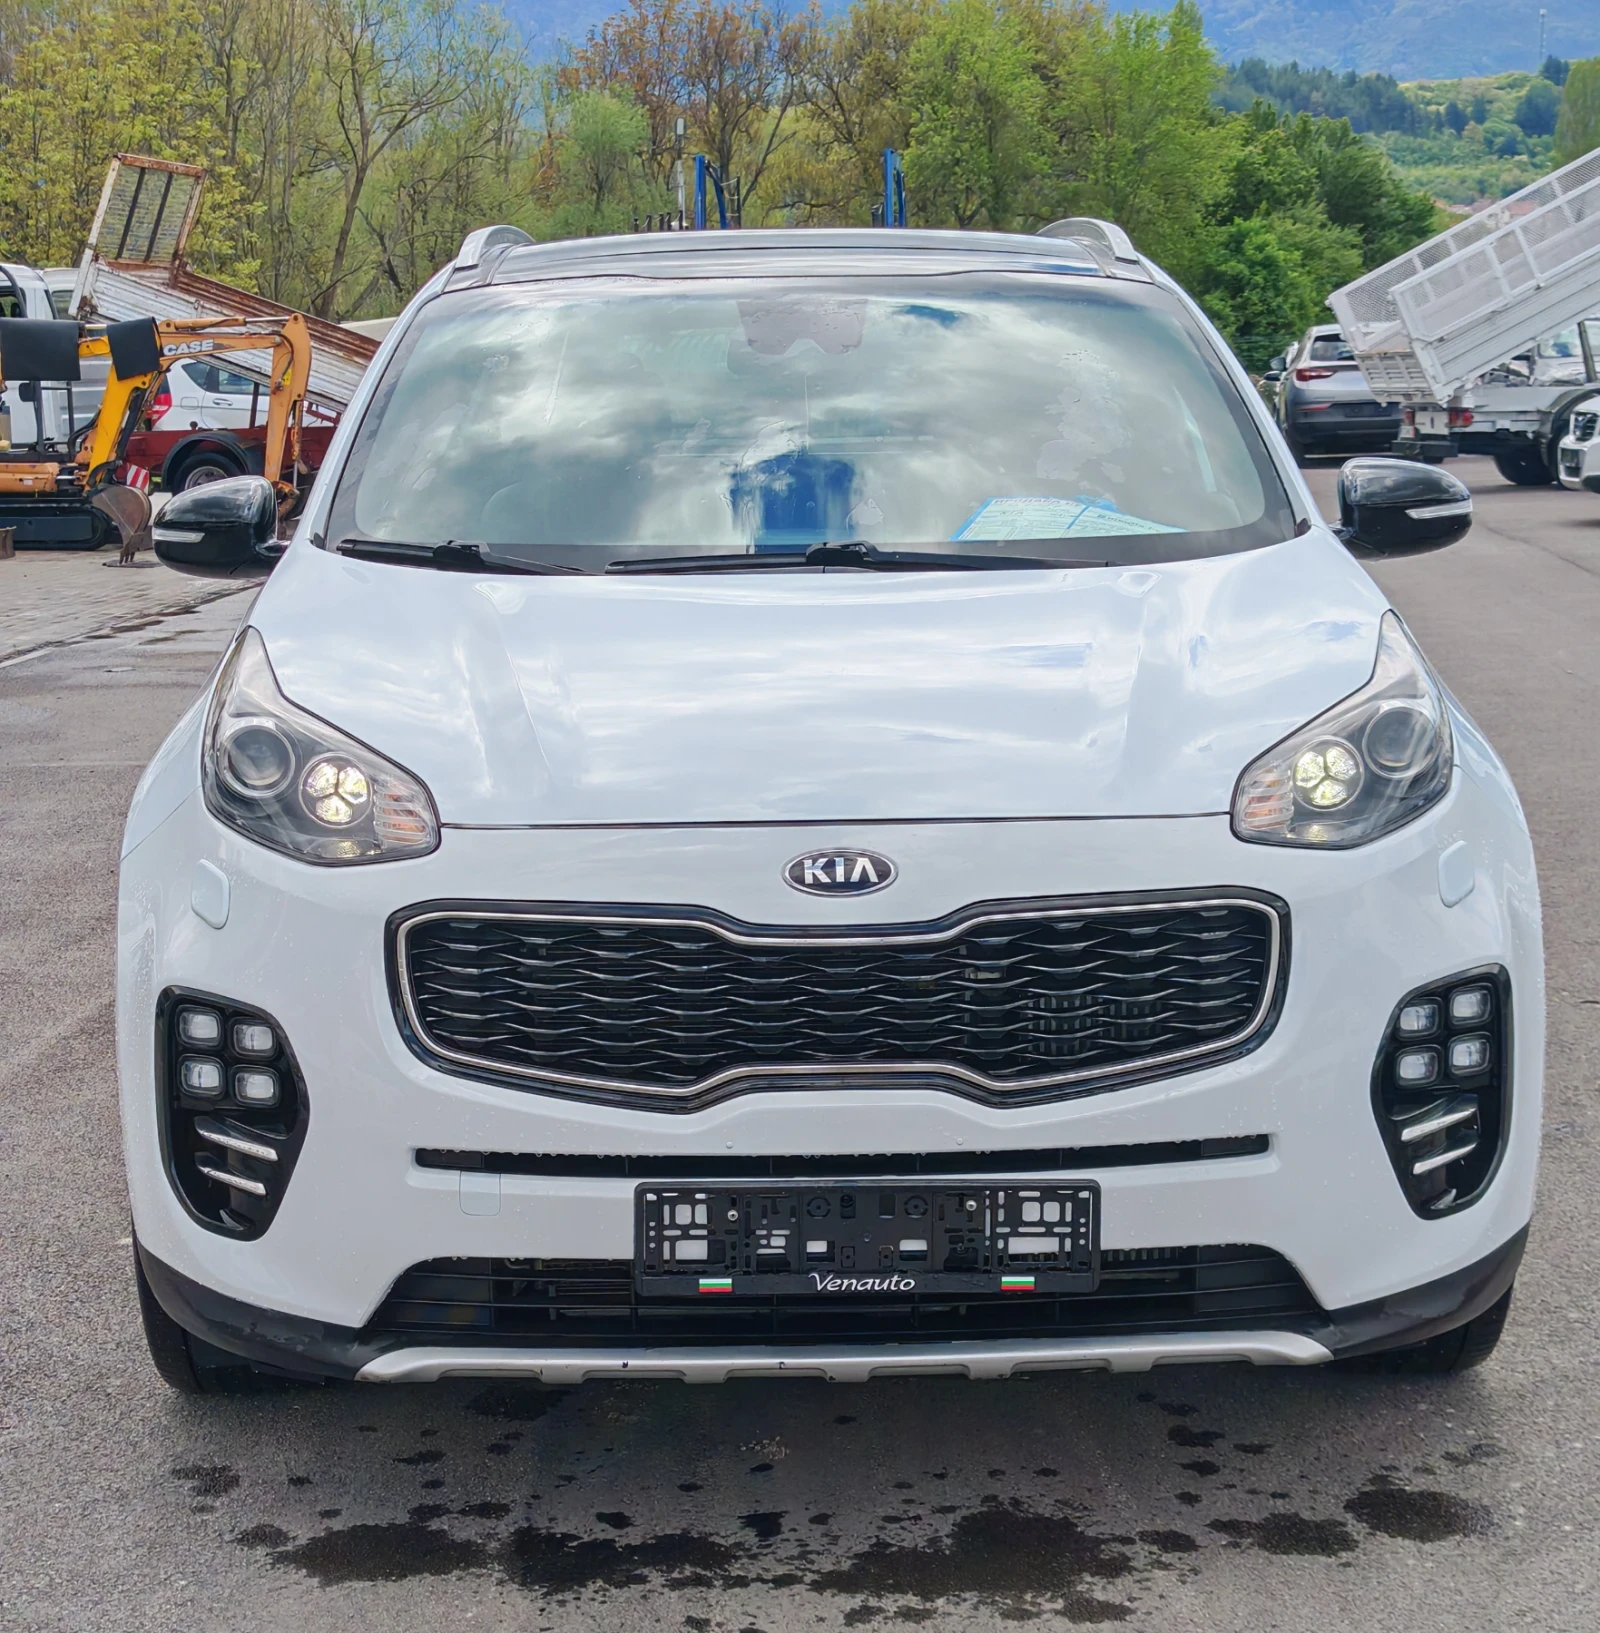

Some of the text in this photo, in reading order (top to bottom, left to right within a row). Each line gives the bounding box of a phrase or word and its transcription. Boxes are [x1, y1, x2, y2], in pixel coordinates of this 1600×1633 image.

[163, 339, 214, 356] CASE
[802, 857, 879, 884] KIA
[808, 1273, 916, 1291] Venauto
